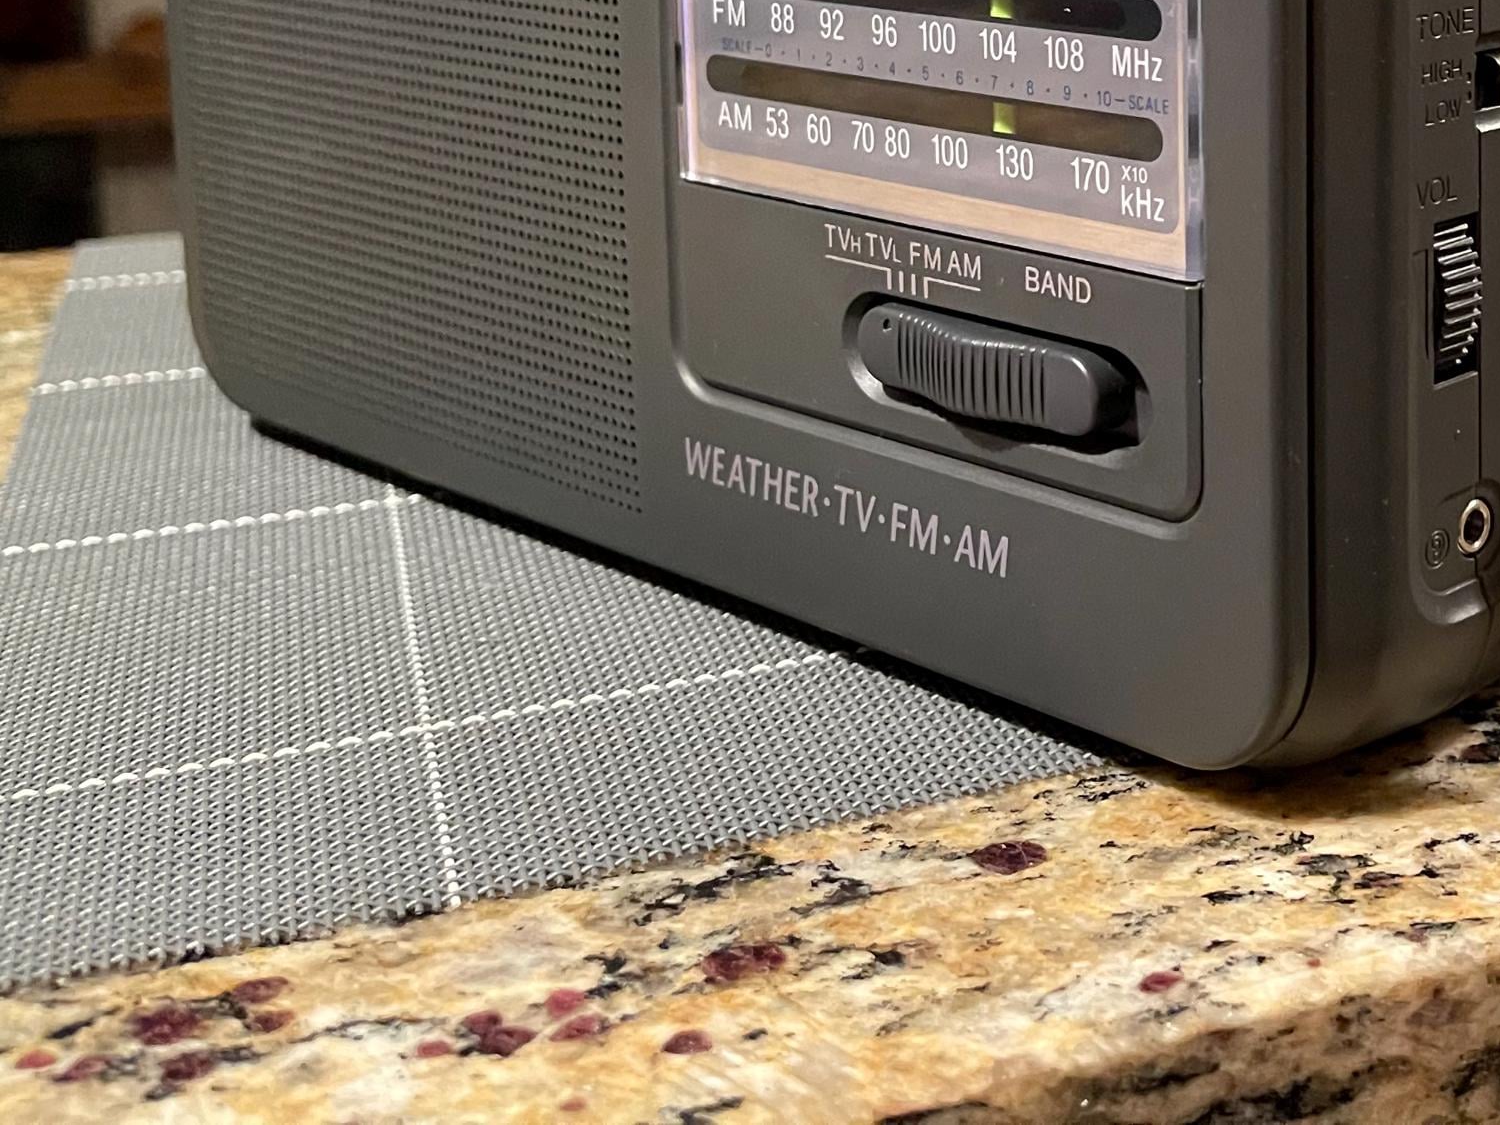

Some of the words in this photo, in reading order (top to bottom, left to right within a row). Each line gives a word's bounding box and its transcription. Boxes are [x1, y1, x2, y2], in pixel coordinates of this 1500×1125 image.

[770, 2, 795, 34] 88
[819, 7, 845, 41] 92
[871, 14, 898, 48] 96
[918, 20, 956, 55] 100
[978, 27, 1017, 64] 104
[1043, 35, 1084, 73] 108
[1111, 44, 1163, 82] MHz
[1415, 6, 1475, 42] TONE
[825, 52, 833, 67] 2
[857, 56, 865, 72] 3
[888, 60, 897, 76] 4
[921, 65, 930, 81] 5
[955, 70, 964, 86] 6
[991, 75, 998, 90] 7
[1026, 80, 1035, 96] 8
[1063, 84, 1072, 101] 9
[1420, 58, 1463, 88] HIGH
[1424, 97, 1462, 127] LOW
[718, 101, 752, 132] AM
[766, 106, 790, 139] 53
[806, 113, 832, 146] 60
[850, 120, 875, 153] 70
[885, 125, 911, 159] 80
[931, 133, 968, 170] 100
[995, 143, 1034, 181] 130
[1070, 156, 1110, 195] 170
[1120, 185, 1165, 223] kHz
[1416, 175, 1458, 210] VOL
[909, 241, 941, 272] FM
[947, 250, 982, 281] AM
[1024, 265, 1092, 304] BAND
